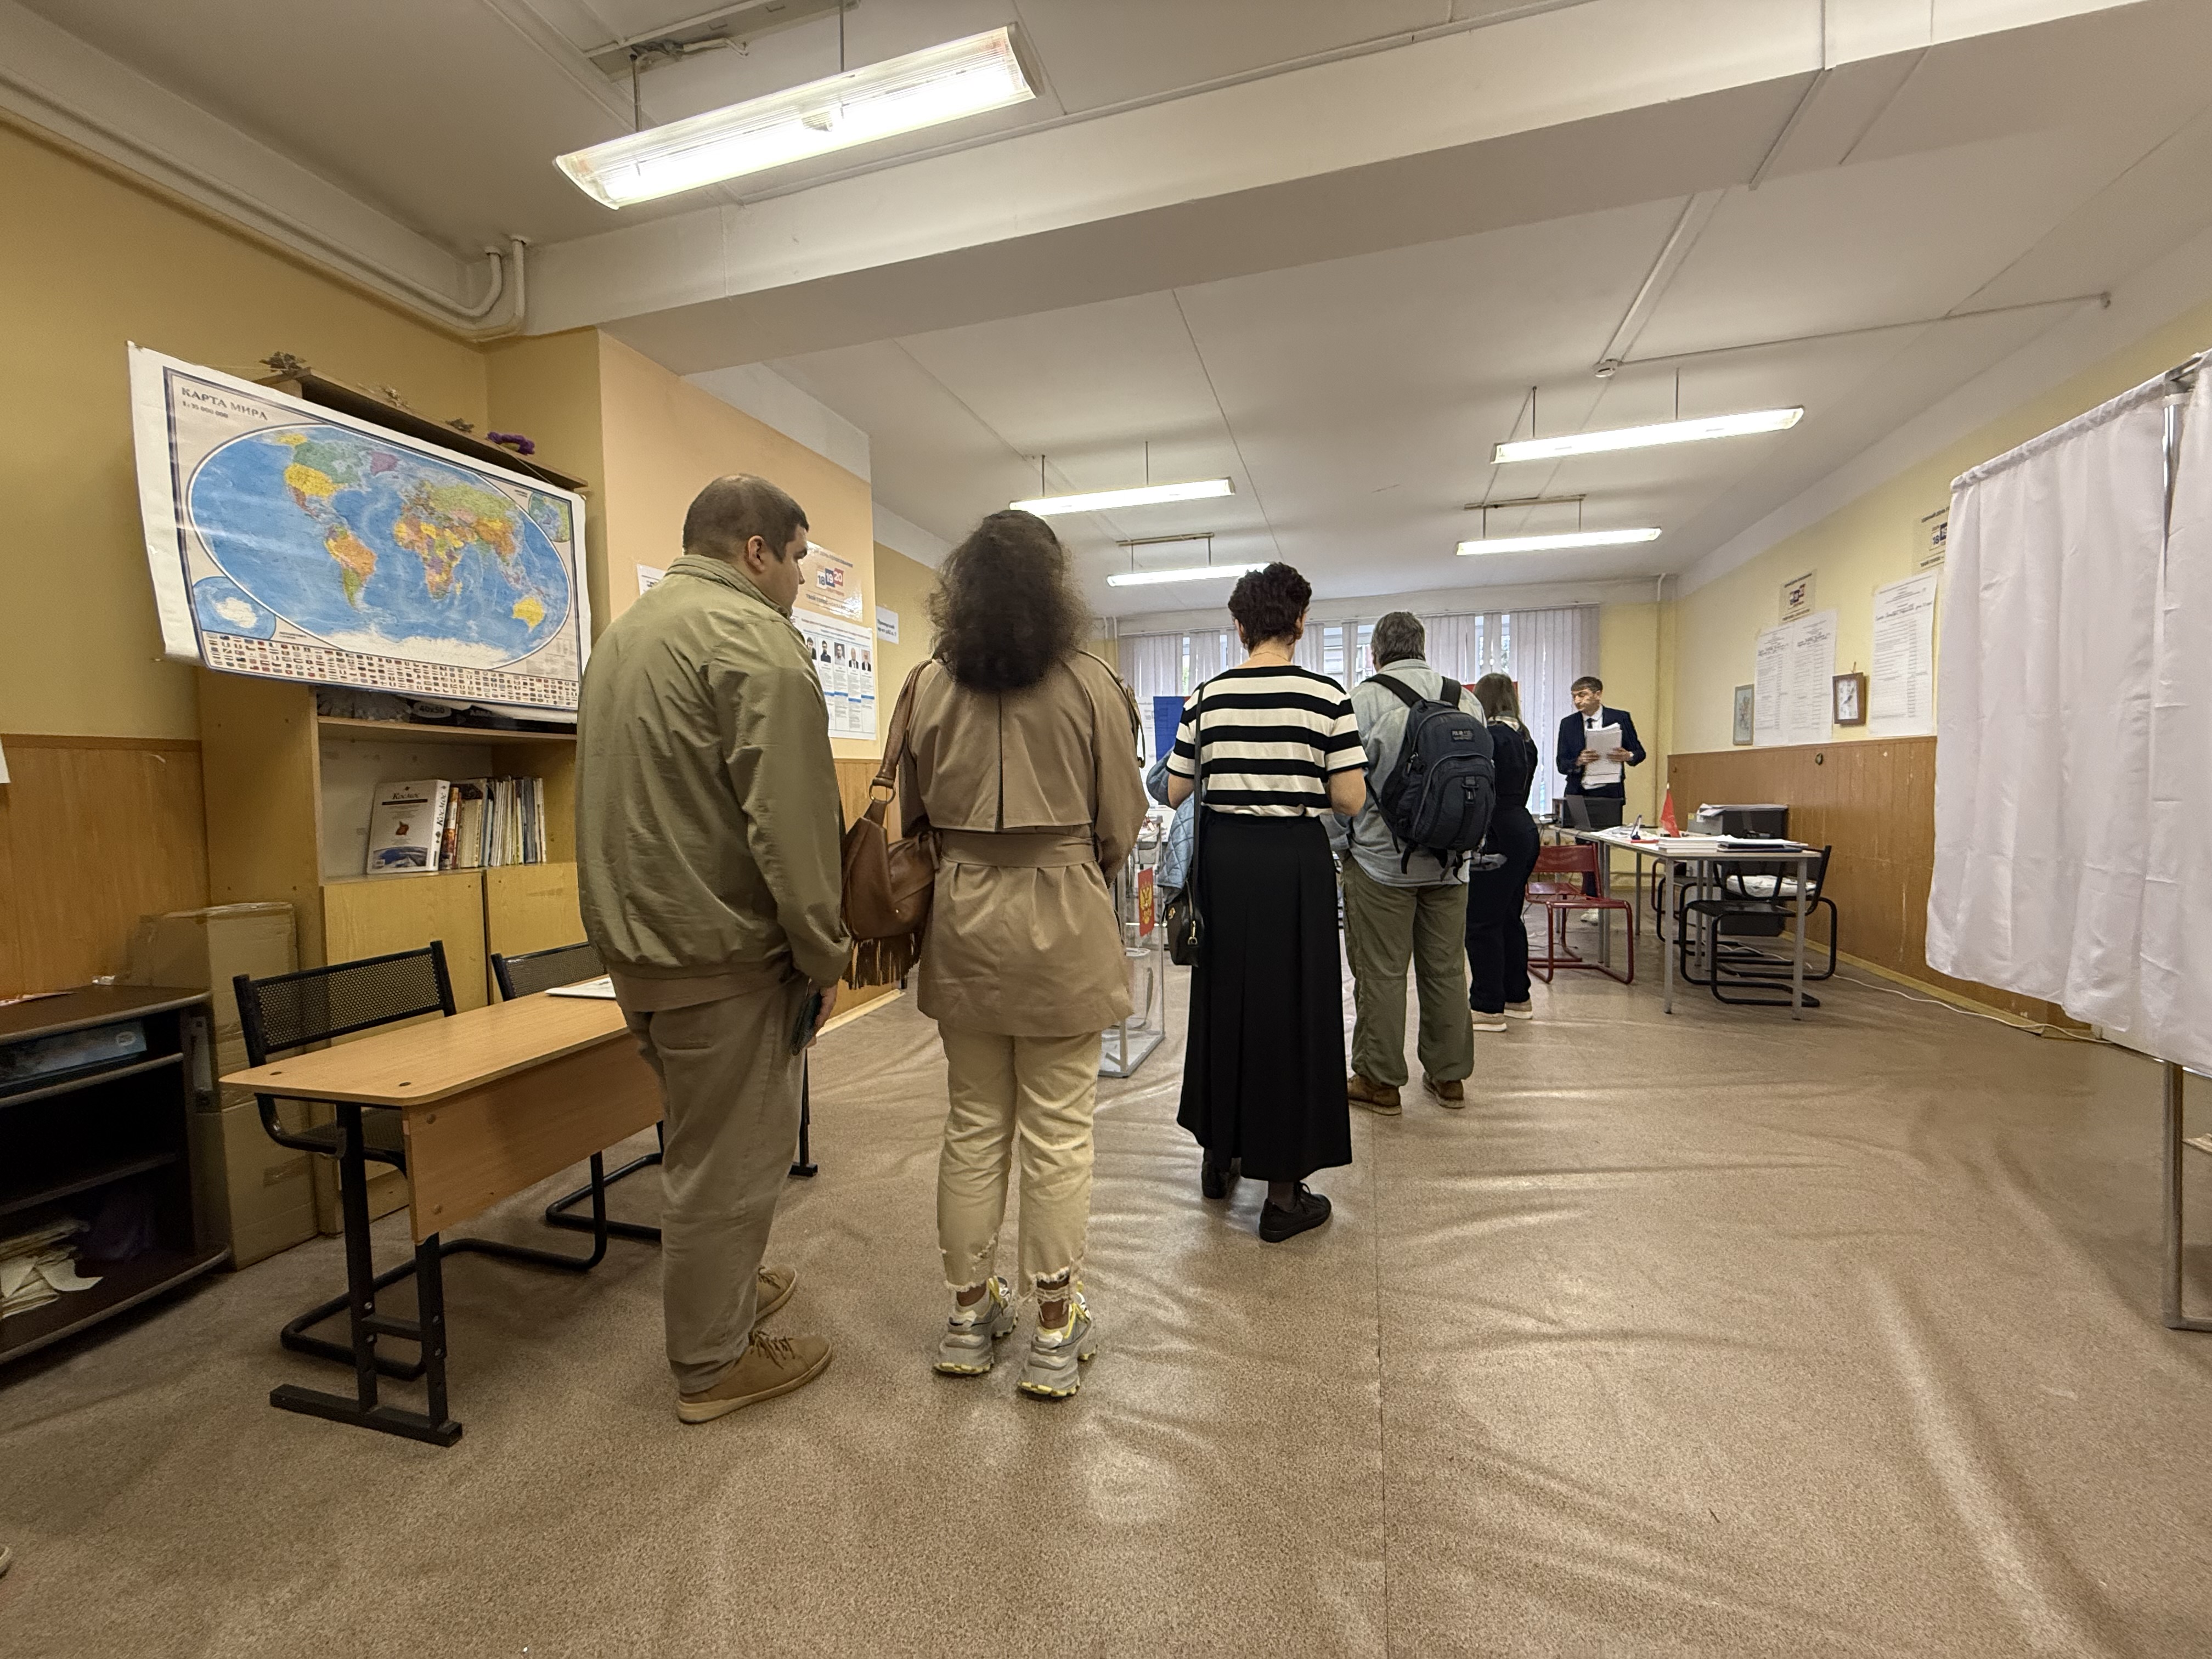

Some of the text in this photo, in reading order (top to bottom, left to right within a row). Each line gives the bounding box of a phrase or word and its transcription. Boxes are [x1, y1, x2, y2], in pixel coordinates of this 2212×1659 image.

[182, 387, 268, 421] КАРТА МИРА
[818, 571, 843, 586] 18 19 20
[437, 792, 447, 826] Космос
